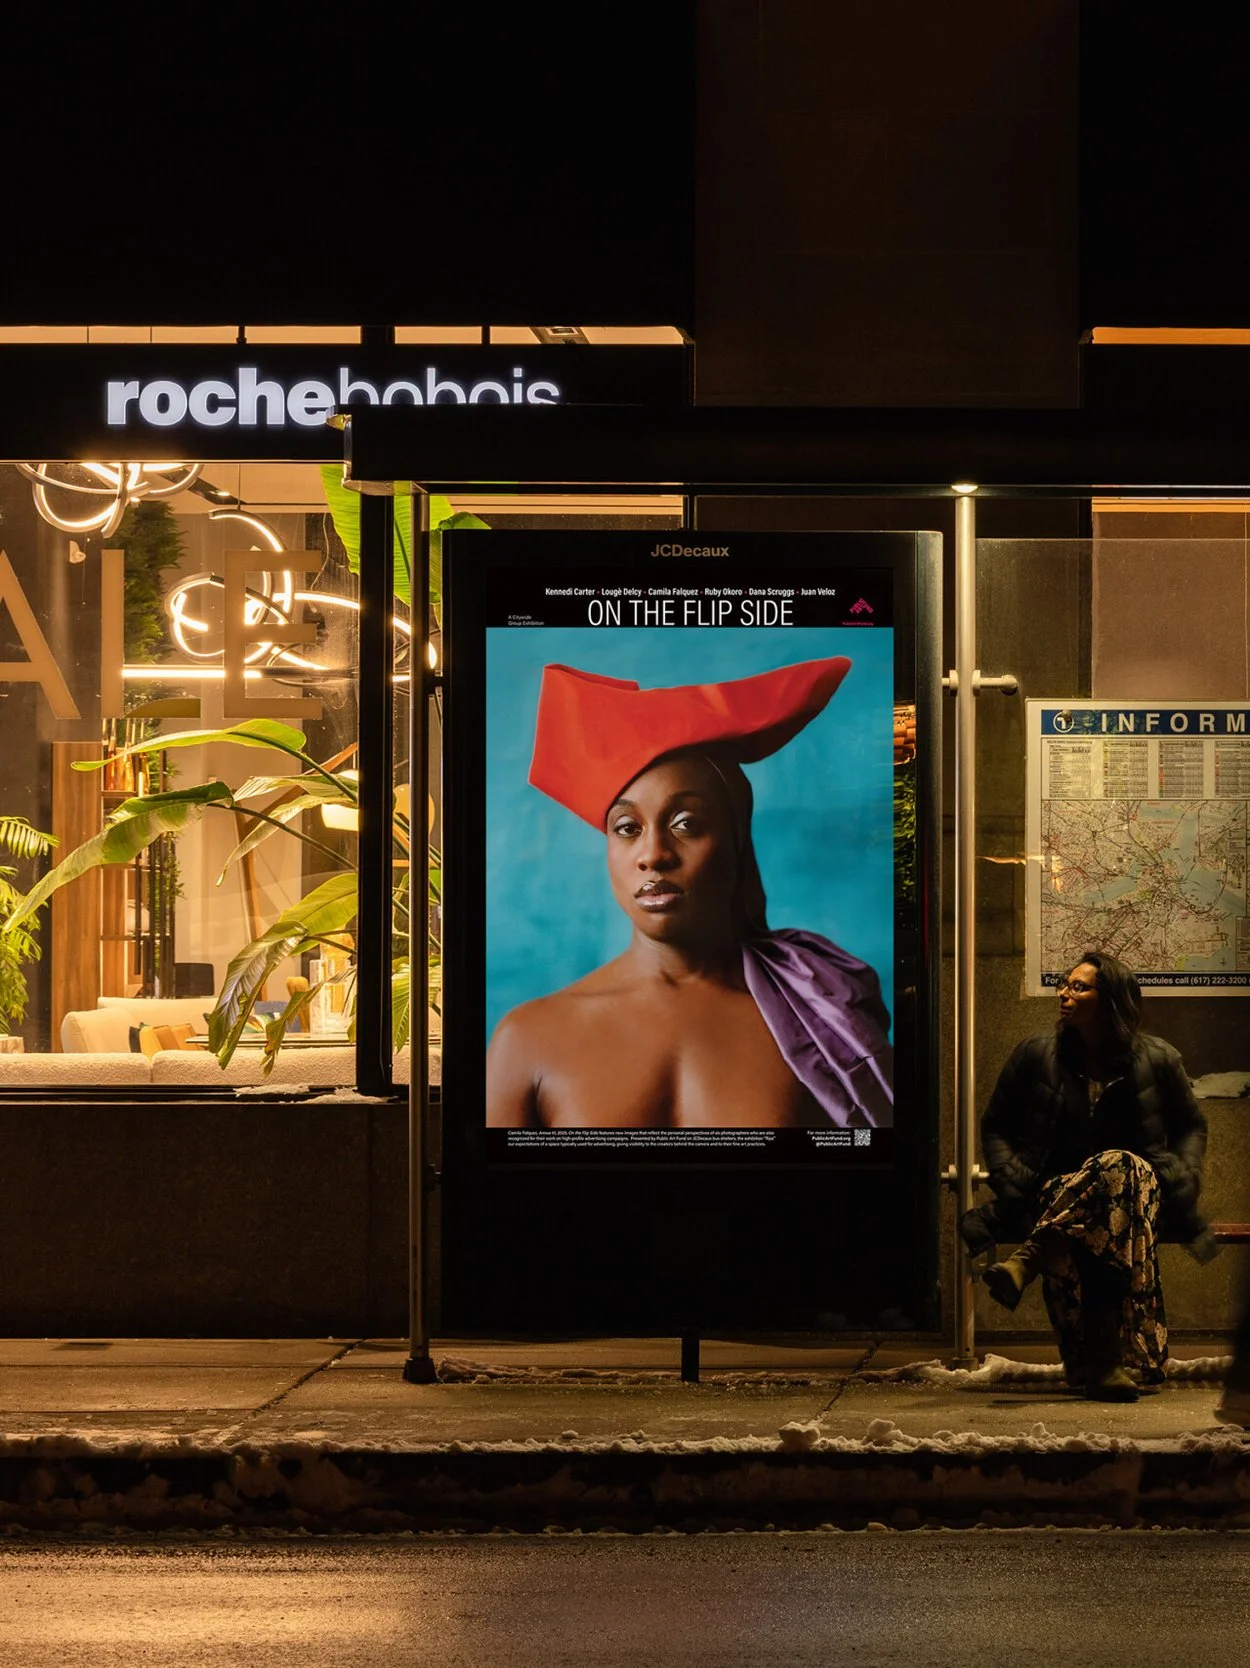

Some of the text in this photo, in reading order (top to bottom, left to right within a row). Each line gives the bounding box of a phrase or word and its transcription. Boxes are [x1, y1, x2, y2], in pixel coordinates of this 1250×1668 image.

[651, 544, 729, 557] JCDecaux
[546, 588, 573, 596] Kennedi
[574, 588, 595, 596] Carter
[624, 588, 642, 597] Delcy
[648, 588, 671, 596] Camila
[673, 588, 698, 597] Falquez
[705, 588, 720, 597] Ruby
[723, 588, 742, 596] Okoro
[749, 588, 766, 596] Dana
[767, 588, 794, 597] Scruggs
[801, 588, 817, 596] Juan
[818, 588, 835, 596] Veloz
[588, 600, 793, 625] ON THE FLIP SIDE
[1045, 976, 1059, 984] For
[1137, 977, 1173, 985] chedules
[1175, 977, 1189, 985] call
[1191, 976, 1211, 986] (617)
